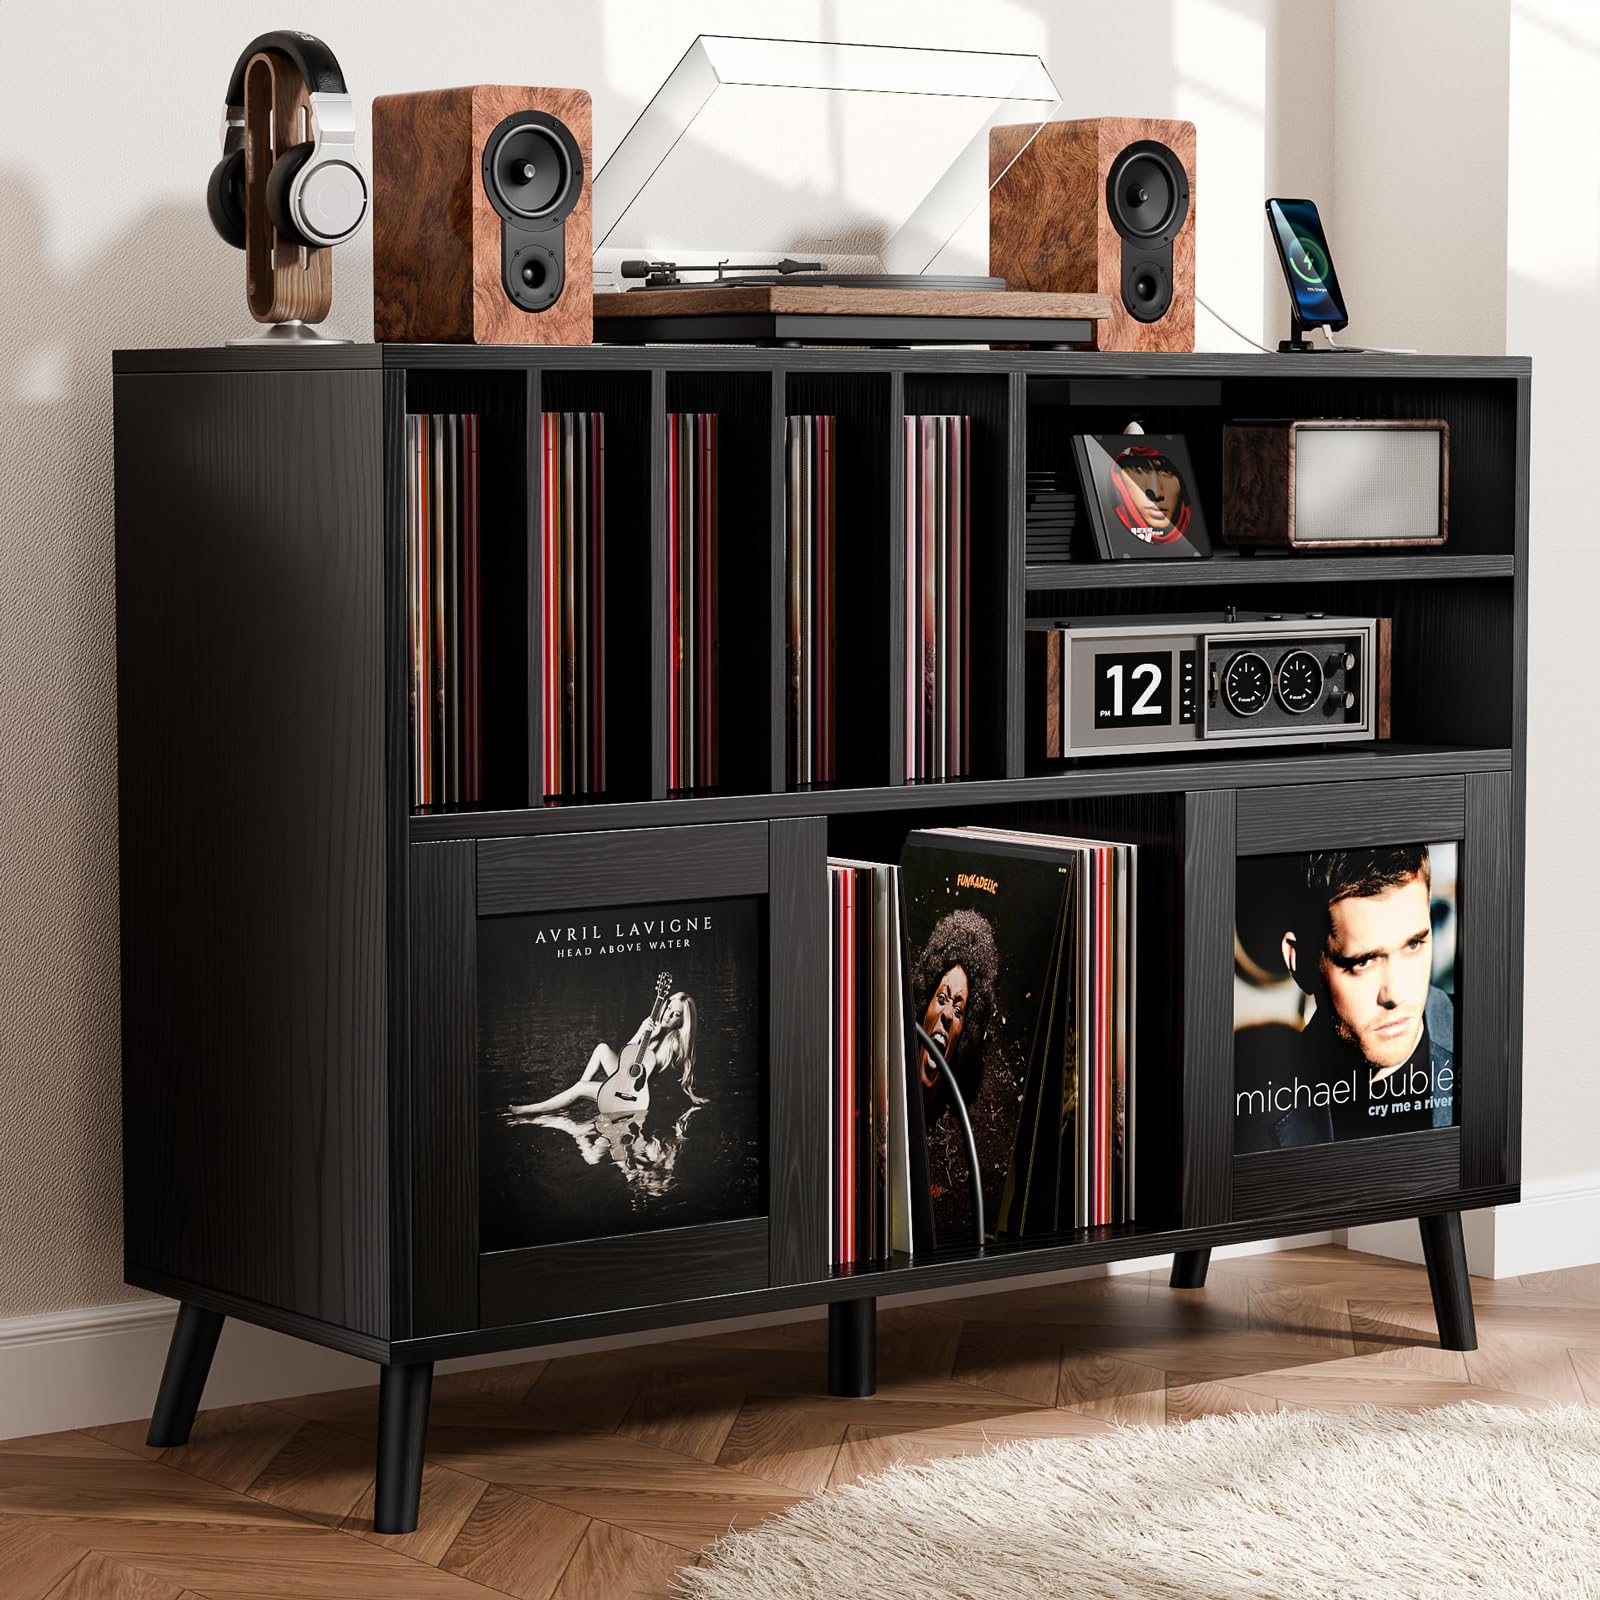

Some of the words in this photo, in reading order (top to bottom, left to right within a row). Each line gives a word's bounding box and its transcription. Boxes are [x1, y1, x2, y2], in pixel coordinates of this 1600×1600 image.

[1106, 663, 1162, 717] 12
[1099, 710, 1111, 718] PM
[956, 873, 999, 895] FUNKADELIC
[534, 926, 601, 944] AVRIL
[615, 916, 713, 937] LAVIGNE
[557, 947, 593, 958] HEAD
[599, 943, 642, 955] ABOVE
[649, 938, 691, 950] WATER
[1236, 1069, 1357, 1117] michael
[1368, 1059, 1454, 1100] bublé
[1368, 1104, 1389, 1118] cry
[1391, 1101, 1412, 1114] me
[1413, 1100, 1422, 1111] a
[1424, 1095, 1454, 1110] river
